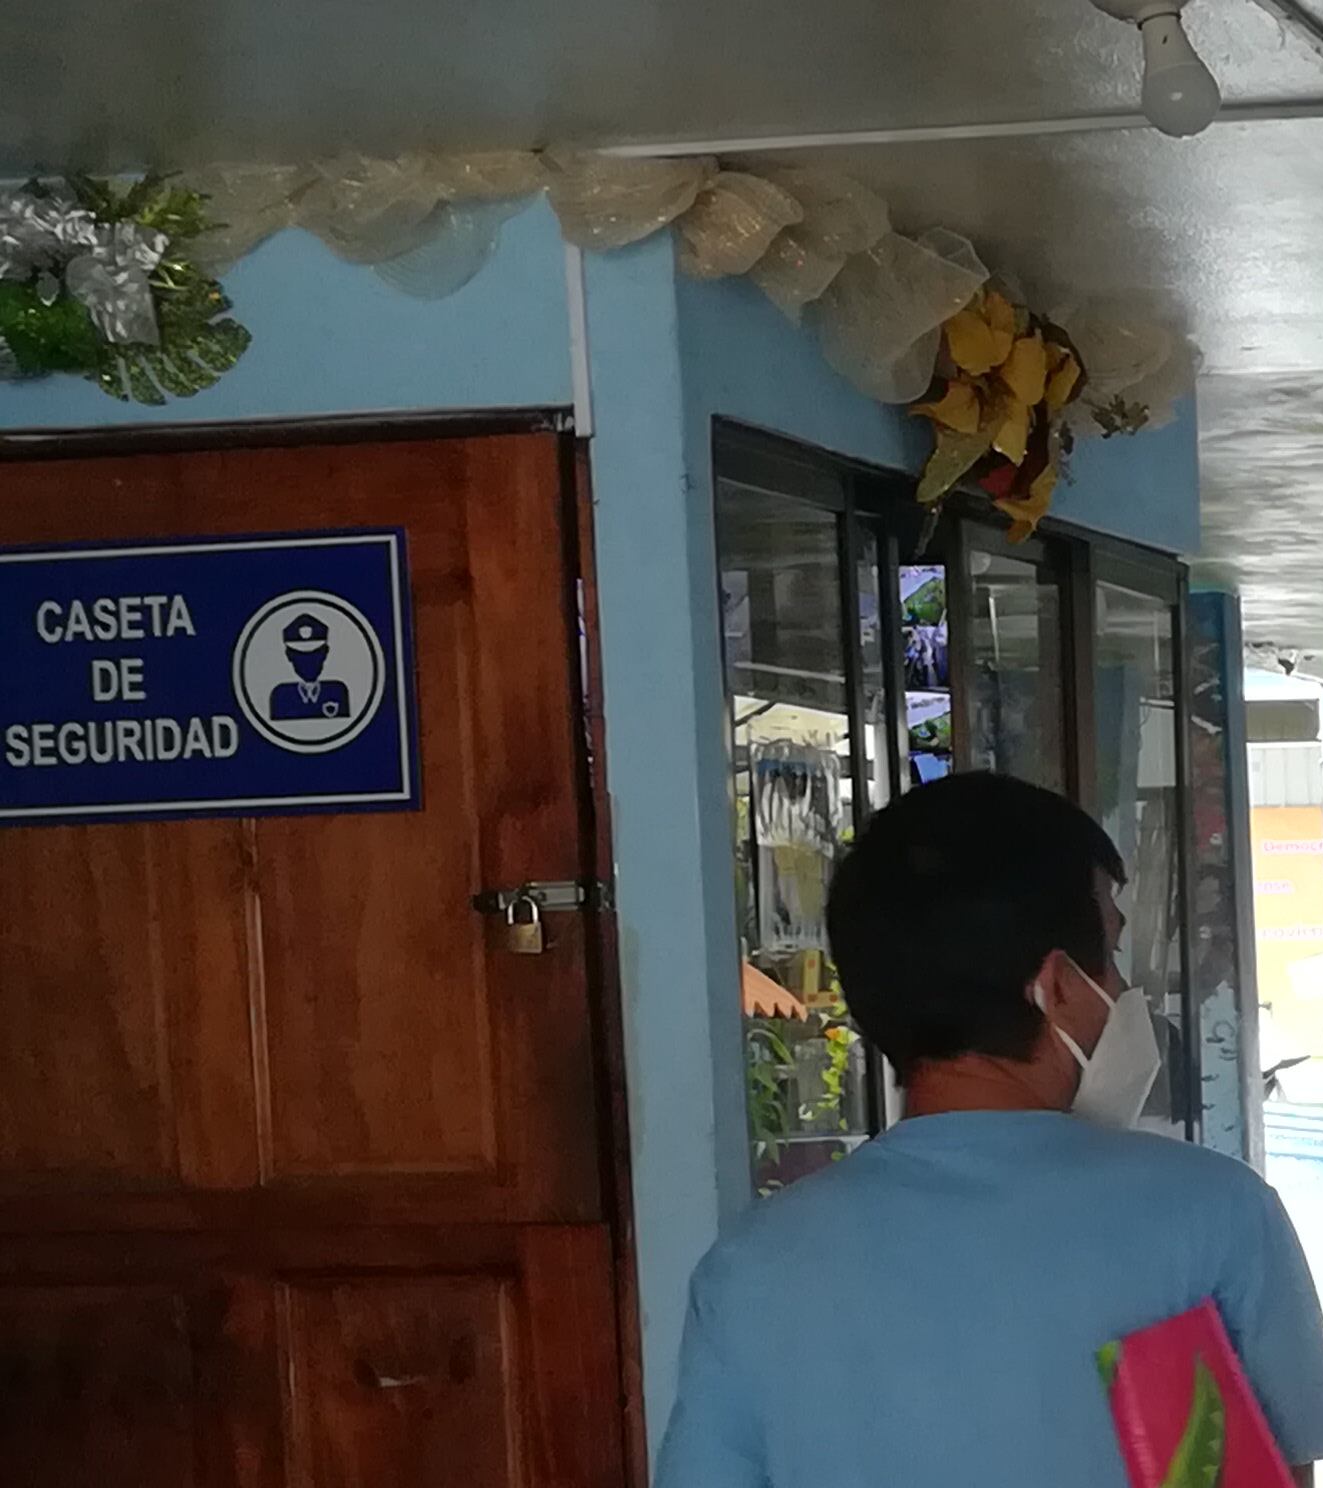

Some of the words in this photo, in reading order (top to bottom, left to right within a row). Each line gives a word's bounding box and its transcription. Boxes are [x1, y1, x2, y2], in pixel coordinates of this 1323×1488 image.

[36, 594, 196, 643] CASETA
[91, 658, 147, 702] DE
[5, 715, 239, 768] SEGURIDAD
